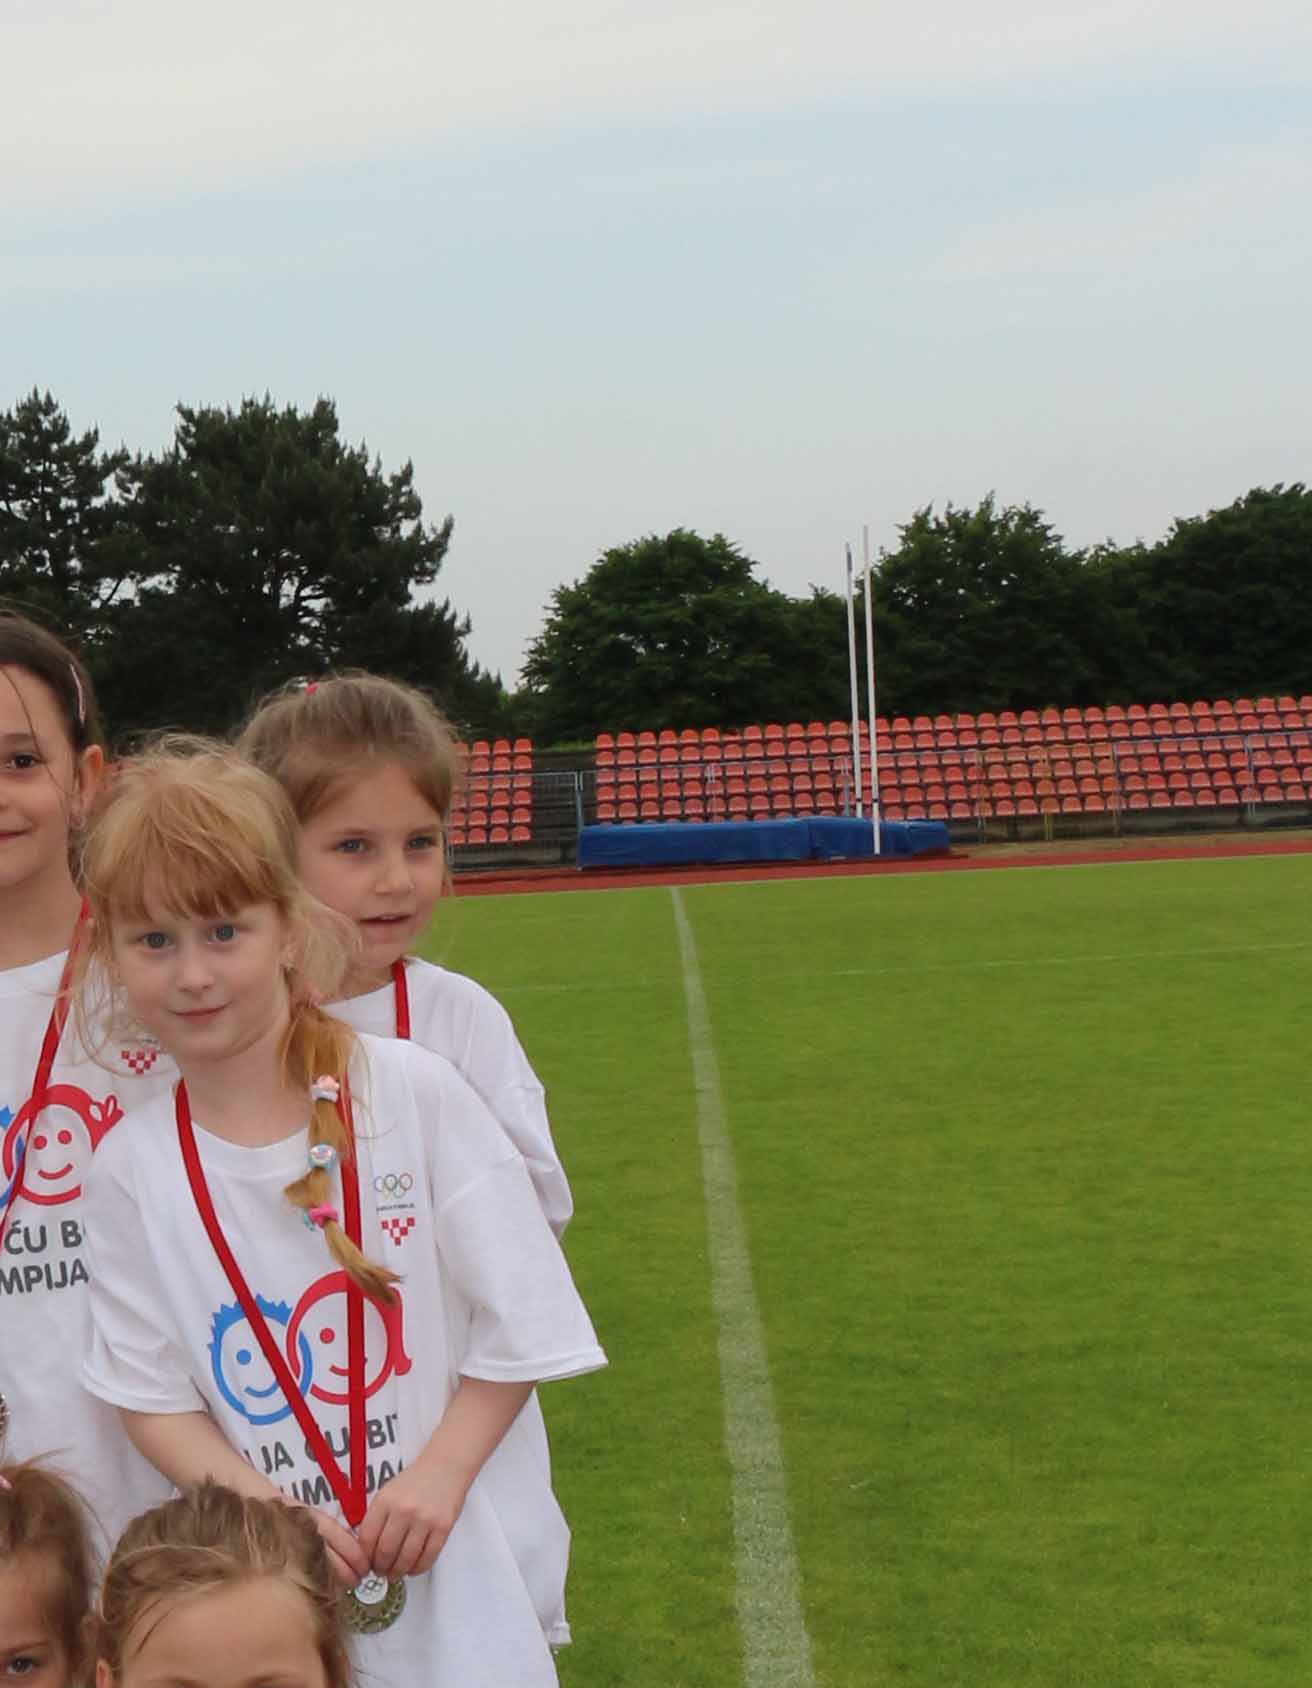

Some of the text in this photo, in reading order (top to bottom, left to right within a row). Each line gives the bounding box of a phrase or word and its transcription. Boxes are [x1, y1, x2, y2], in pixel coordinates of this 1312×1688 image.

[4, 1219, 48, 1255] ĆU
[60, 1219, 87, 1249] B
[261, 1441, 294, 1475] JA
